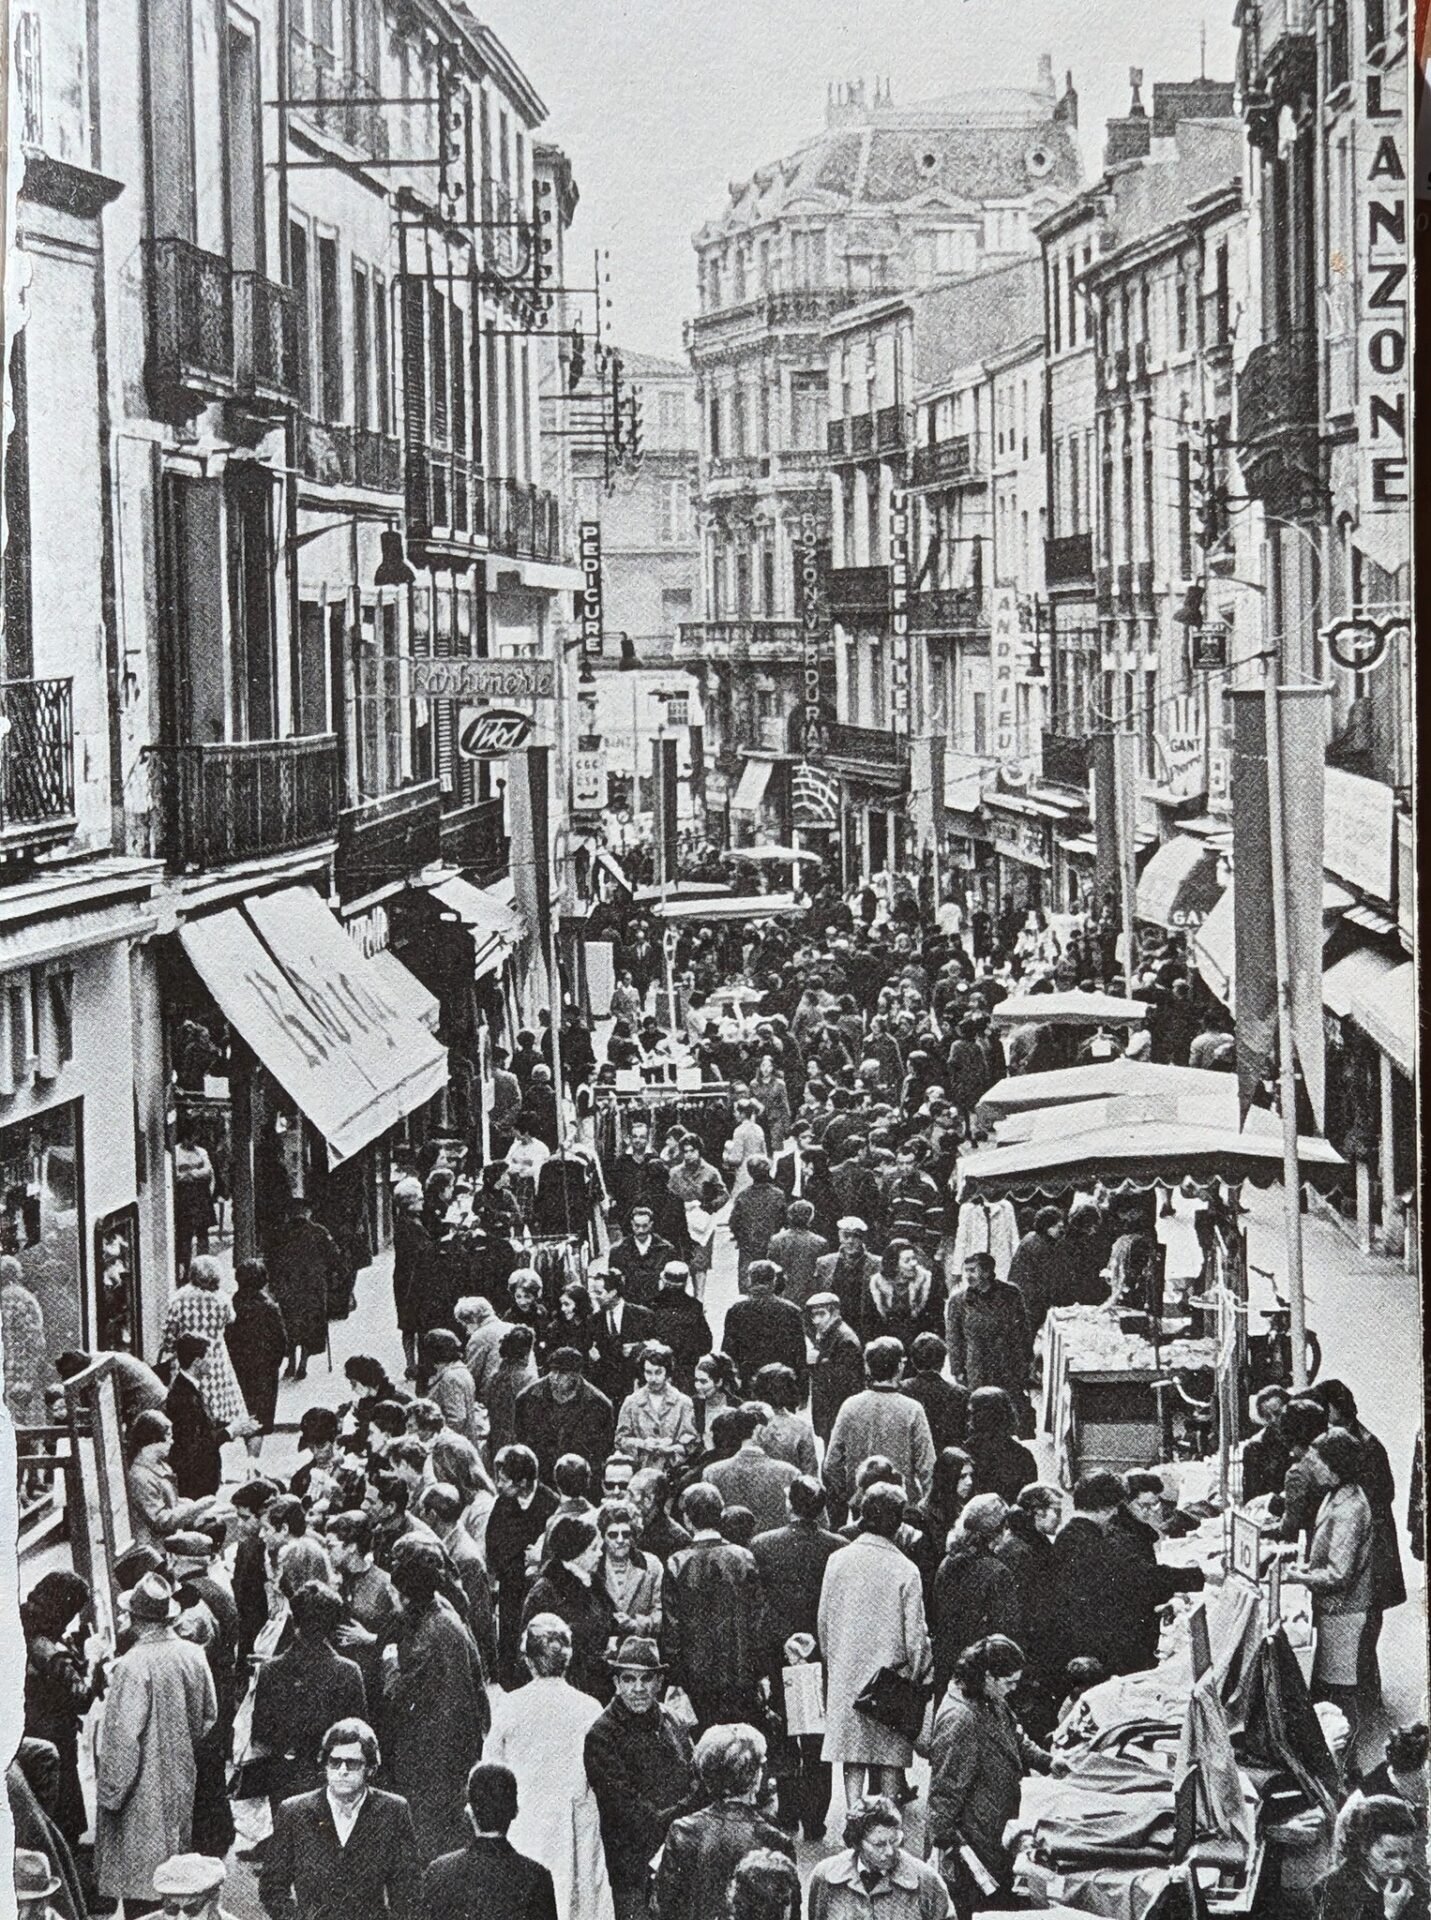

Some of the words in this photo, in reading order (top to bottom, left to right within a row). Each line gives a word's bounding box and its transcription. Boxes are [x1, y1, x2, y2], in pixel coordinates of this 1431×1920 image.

[1366, 75, 1409, 502] LANZONE
[582, 525, 600, 652] PEDICURE
[893, 489, 909, 734] TELEFUNKEN
[997, 596, 1012, 749] ANDRIEU
[1170, 738, 1201, 753] GANT
